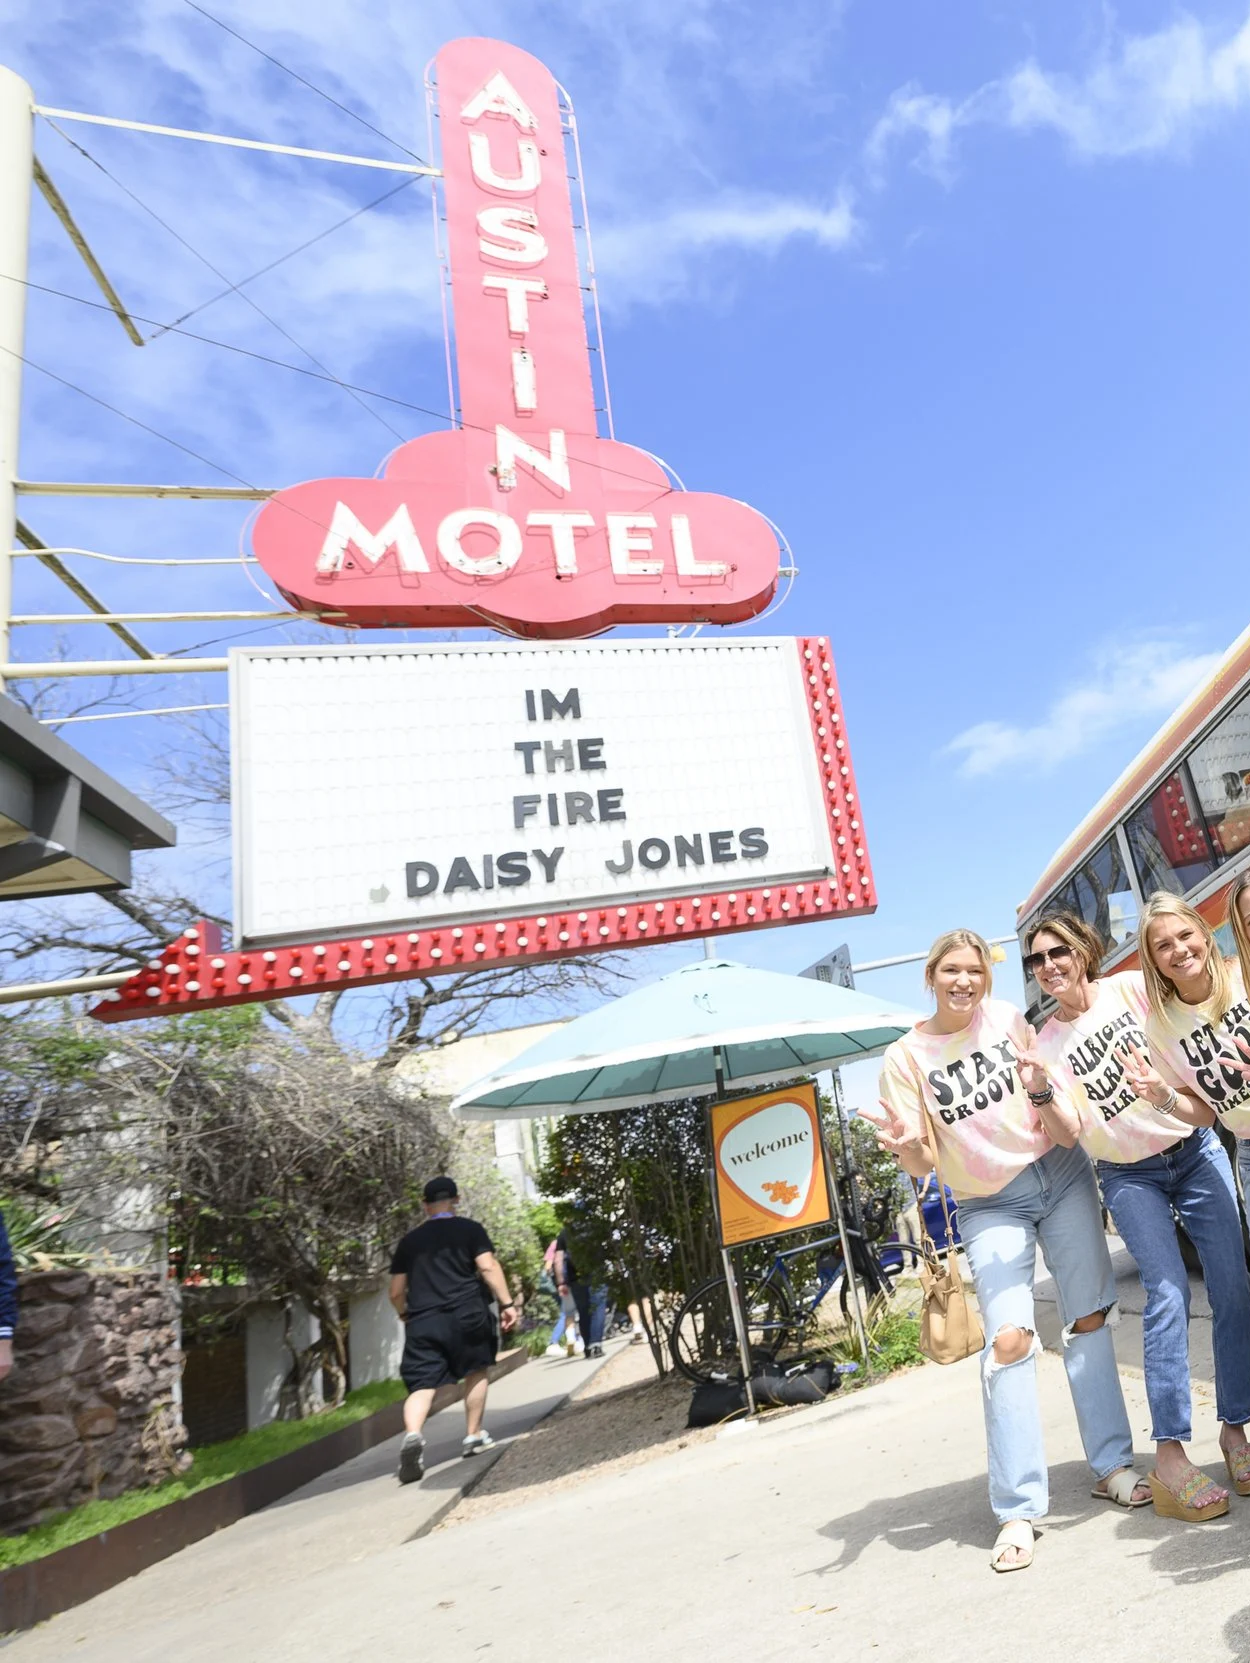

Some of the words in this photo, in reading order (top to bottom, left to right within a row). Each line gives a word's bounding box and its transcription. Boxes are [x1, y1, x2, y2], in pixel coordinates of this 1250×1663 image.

[460, 71, 572, 493] AUSTIN
[315, 500, 738, 581] MOTEL
[525, 687, 582, 722] IM
[514, 737, 607, 774] THE
[513, 788, 627, 829] FIRE
[405, 846, 565, 898] DAISY
[605, 827, 770, 873] JONES
[928, 1039, 1017, 1107] STAY
[1067, 1011, 1138, 1076] ALRIGHT
[1179, 1022, 1222, 1068] LET
[939, 1065, 1017, 1125] GROOV
[730, 1130, 809, 1167] welcome
